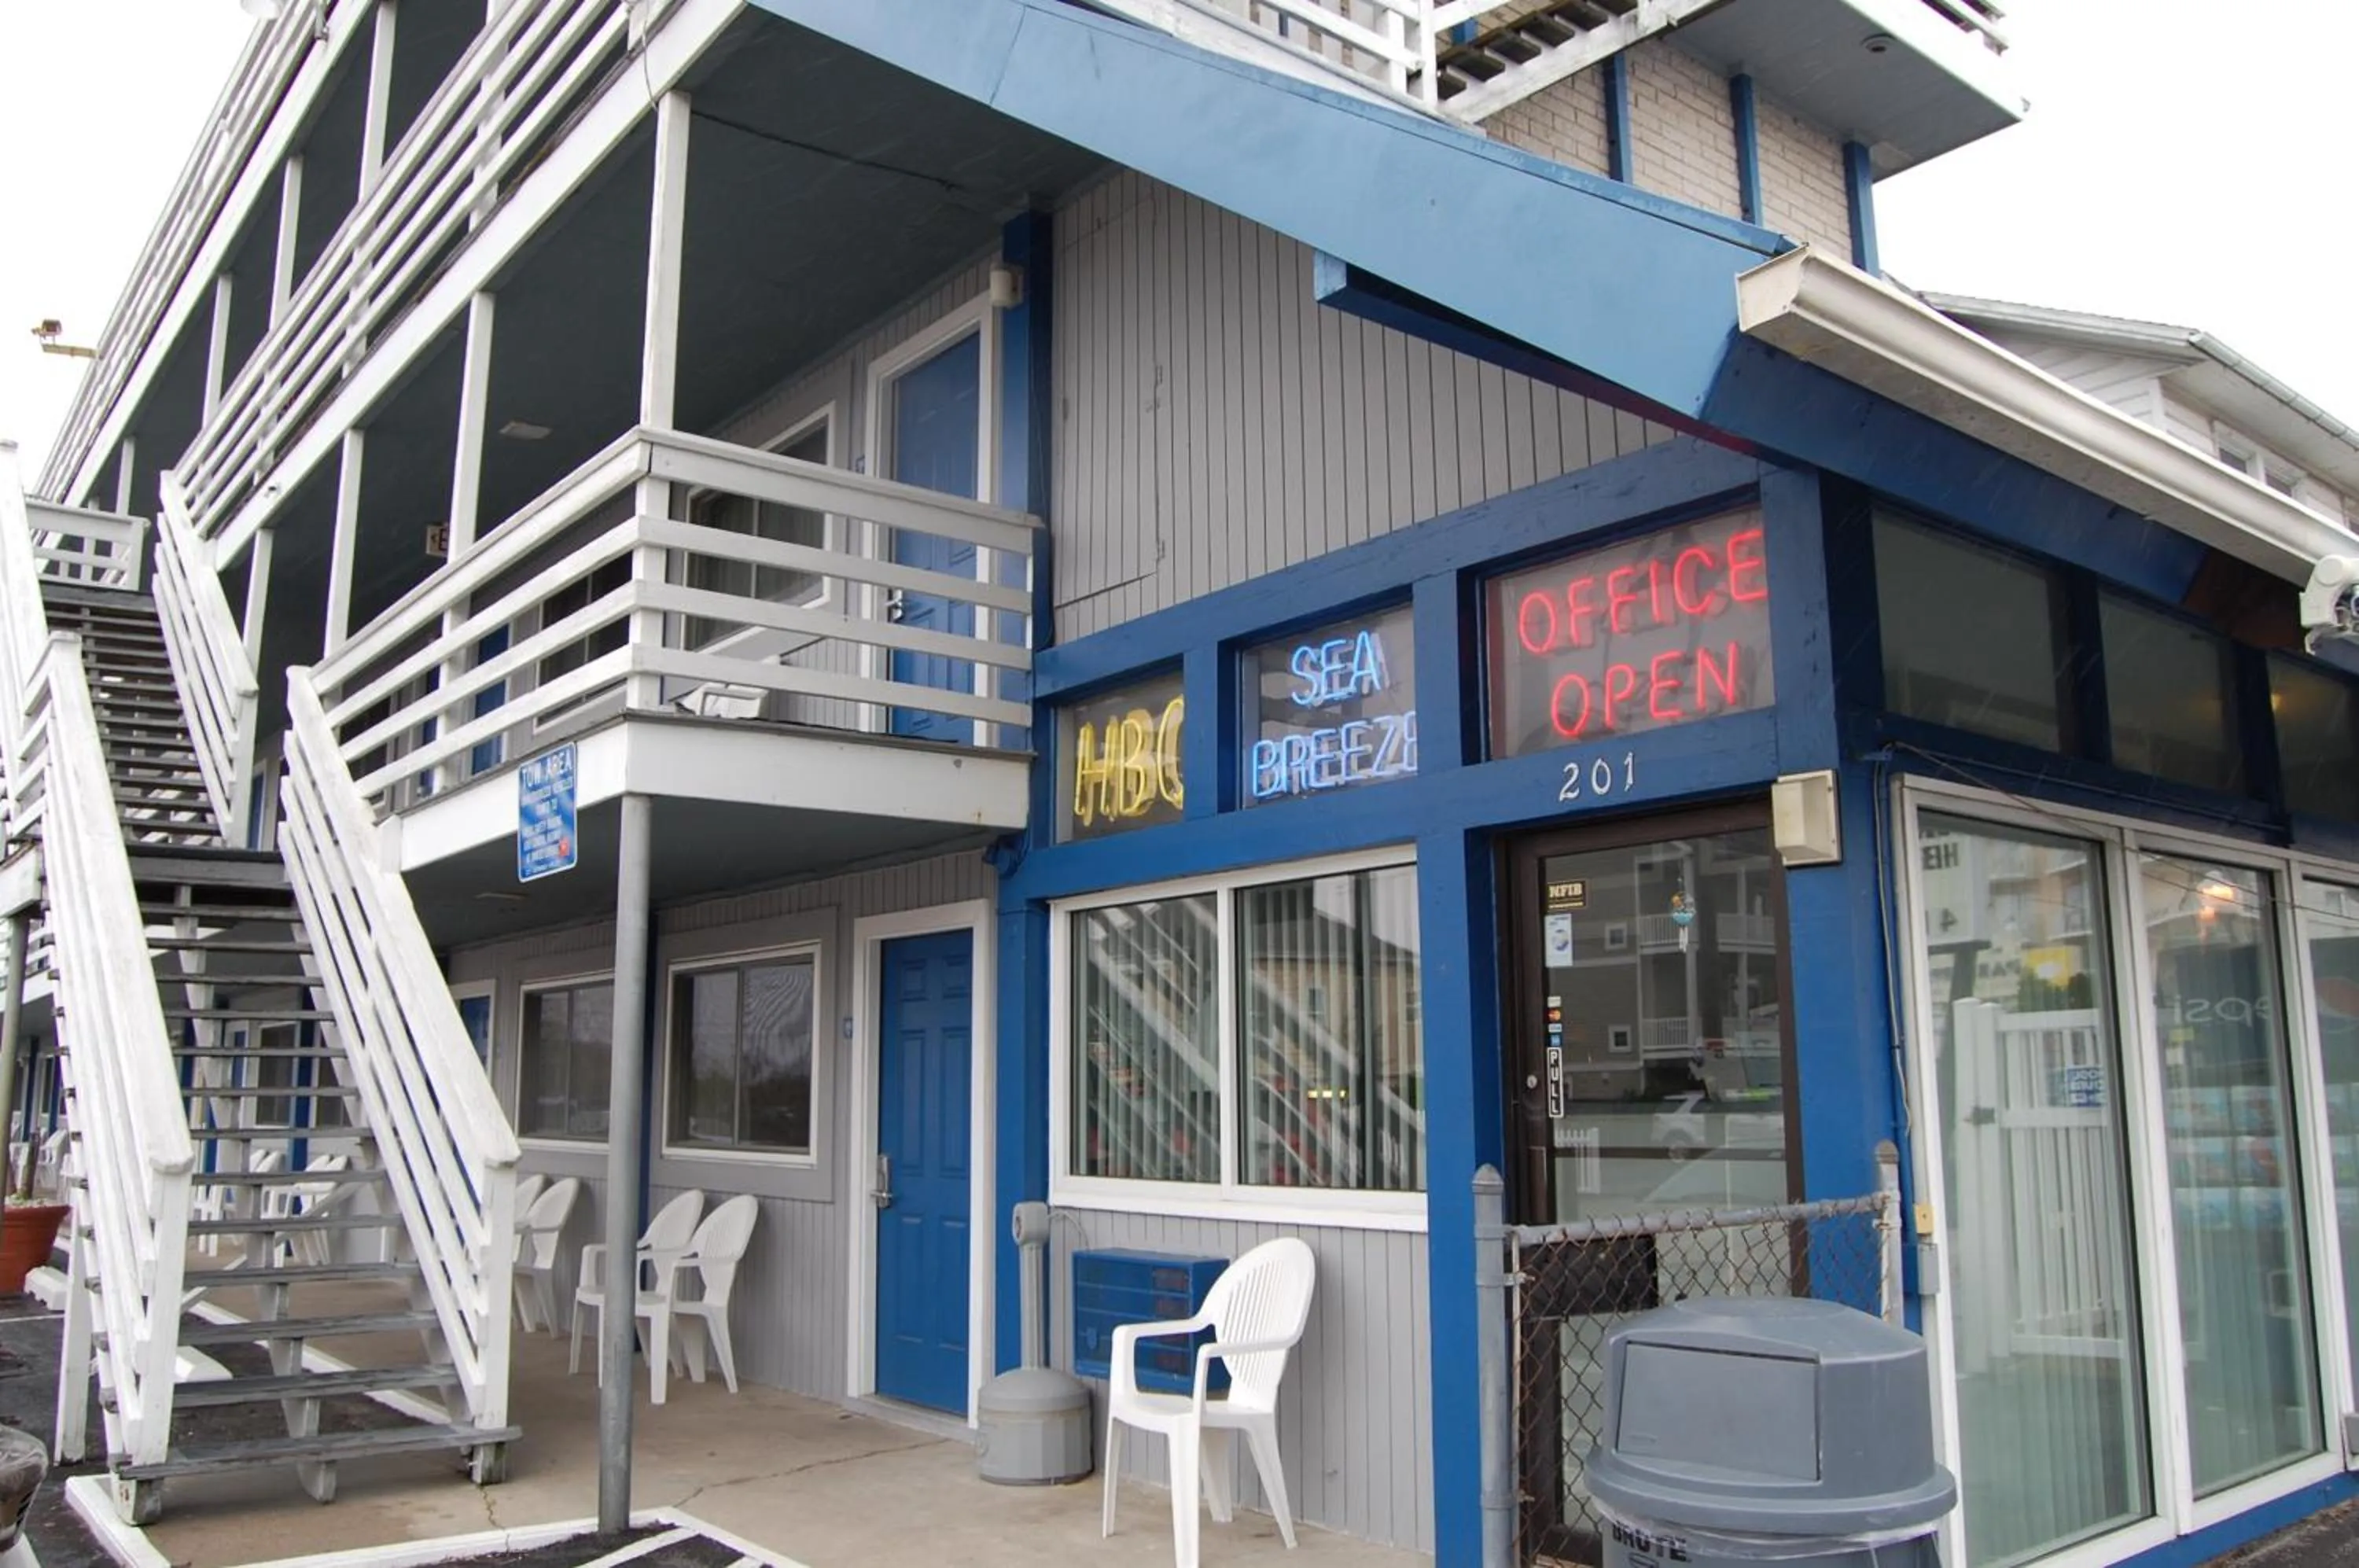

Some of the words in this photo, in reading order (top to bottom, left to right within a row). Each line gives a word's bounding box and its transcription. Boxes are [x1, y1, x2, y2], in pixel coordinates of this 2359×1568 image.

[1518, 528, 1768, 653] OFFICE
[1291, 630, 1382, 706] SEA
[1550, 640, 1740, 738] OPEN
[522, 761, 542, 791] TOW
[544, 748, 573, 782] AREA
[1252, 710, 1418, 797] BREEZE
[1558, 752, 1636, 803] 201
[1550, 1051, 1561, 1115] PULL
[1612, 1519, 1687, 1562] BRUTE
